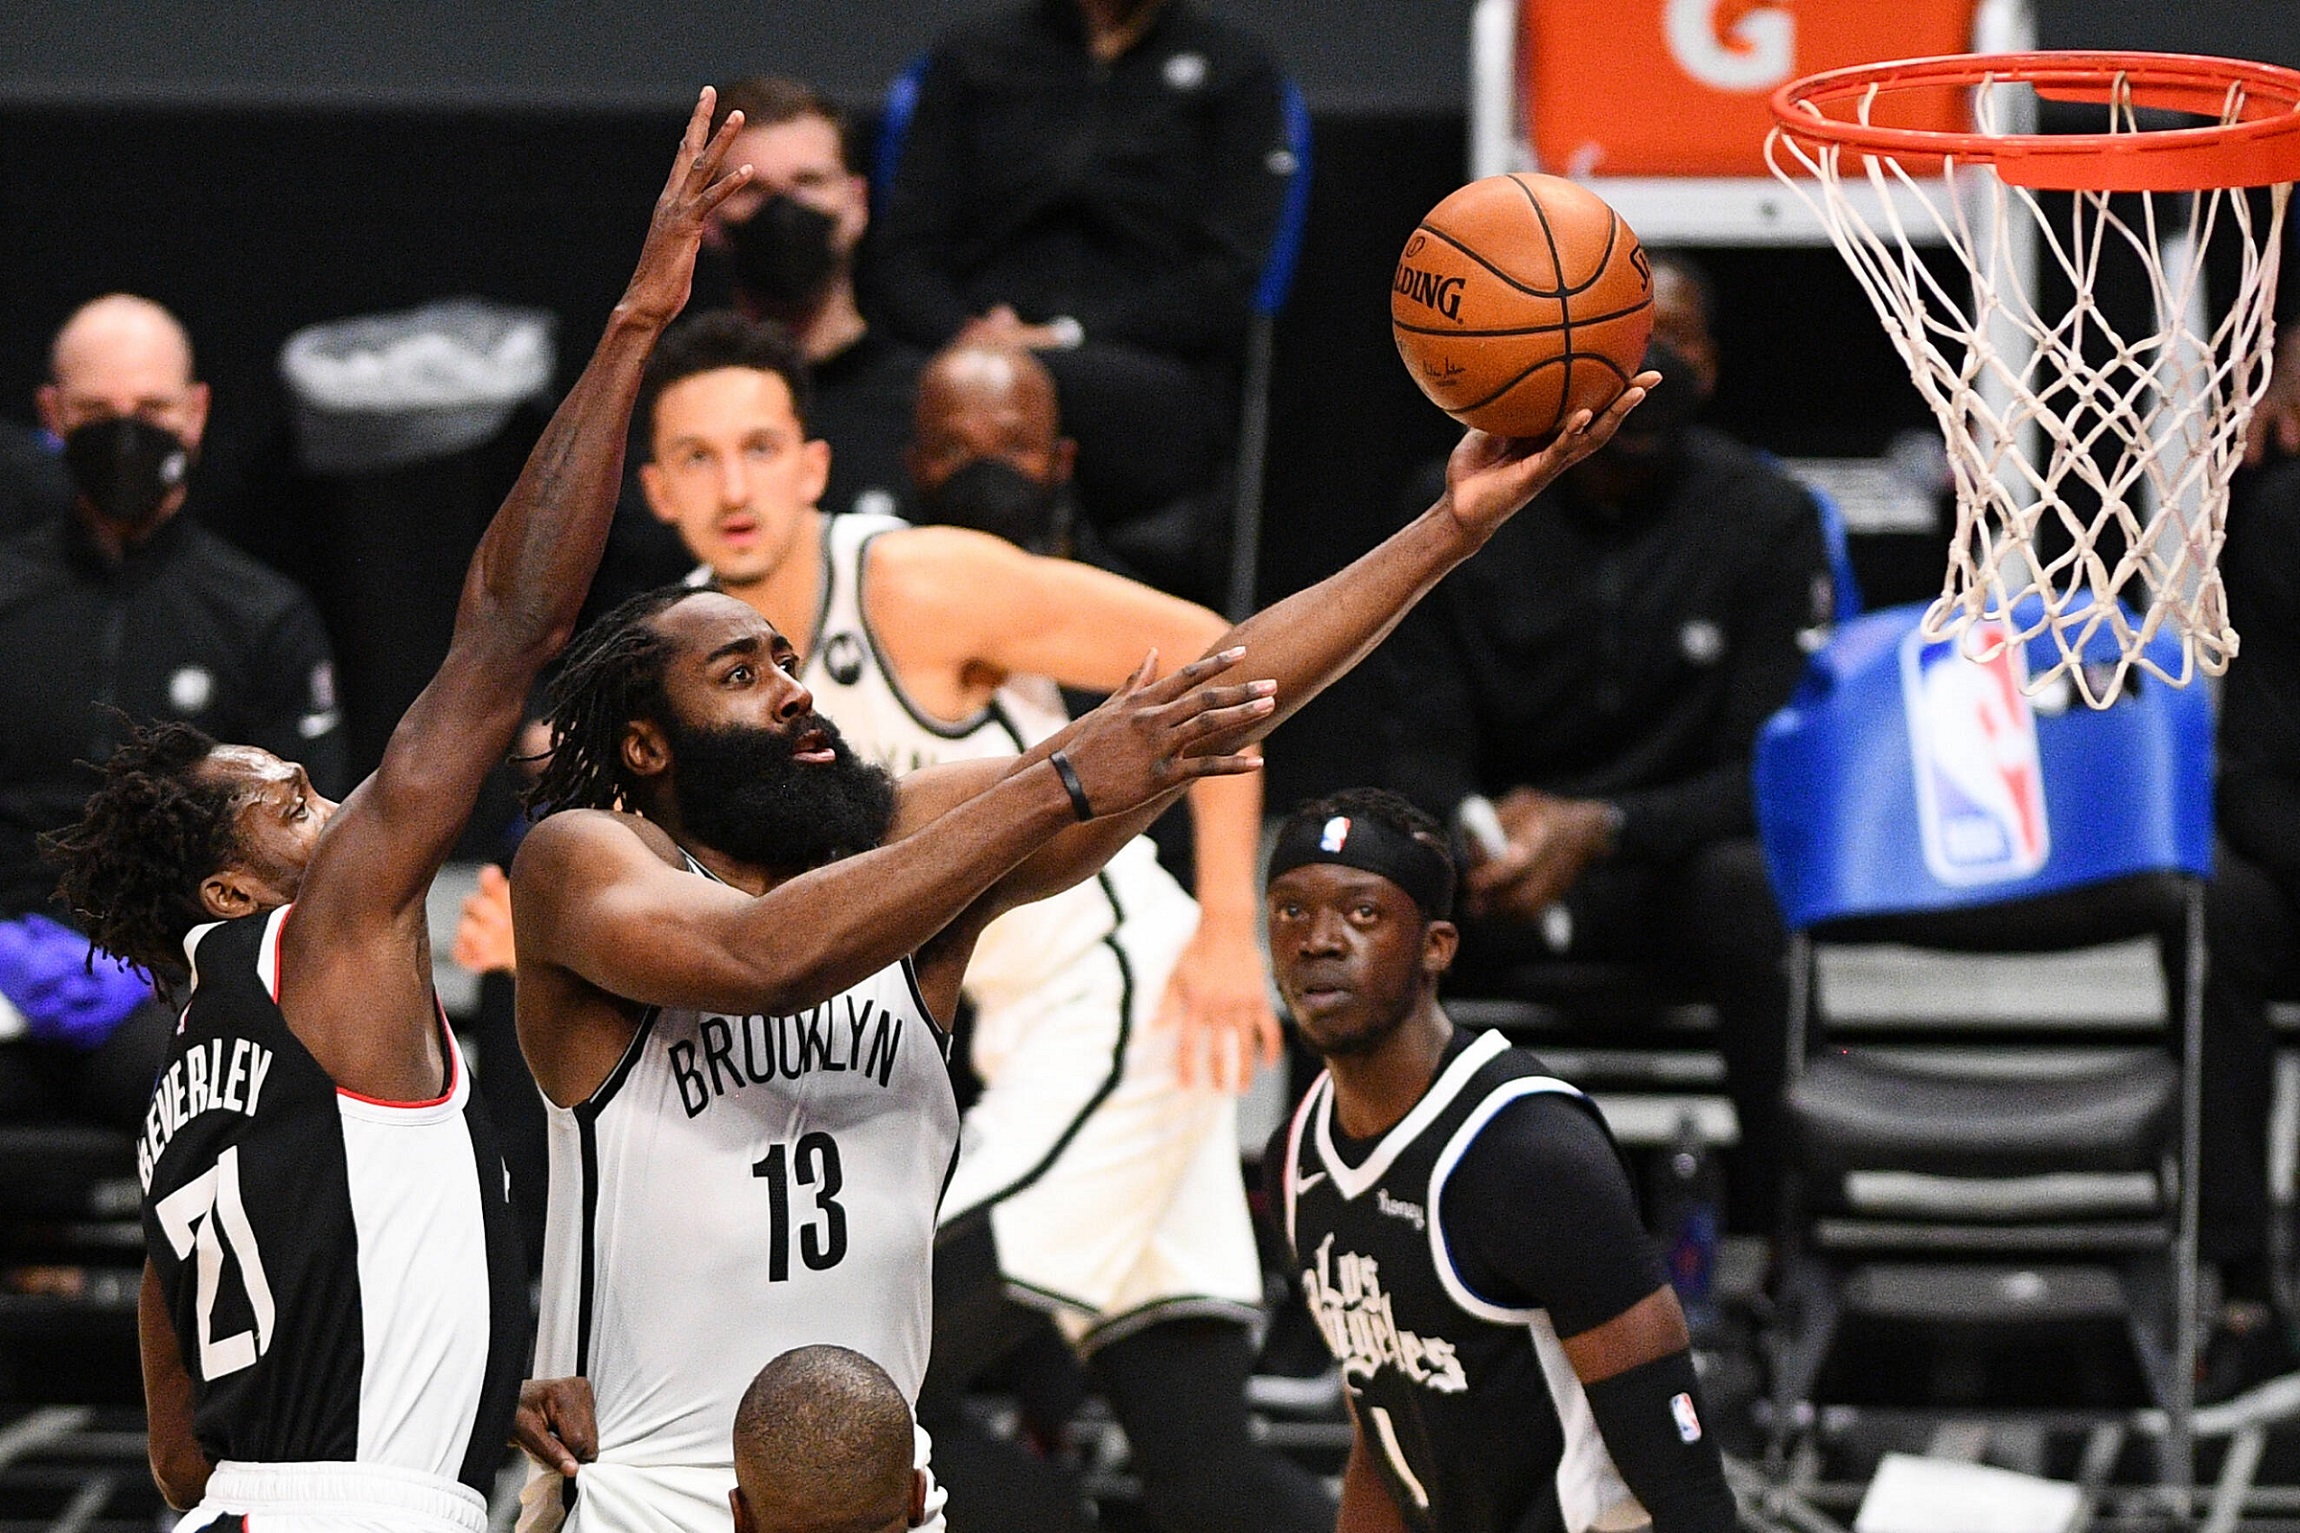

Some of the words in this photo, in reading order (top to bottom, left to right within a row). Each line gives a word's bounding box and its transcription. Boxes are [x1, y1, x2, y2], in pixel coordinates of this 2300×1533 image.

[1662, 0, 1797, 92] G
[1394, 263, 1466, 321] LDING
[136, 1037, 273, 1196] BEVERLEY
[668, 994, 903, 1119] BROOKLYN
[155, 1144, 275, 1382] 21
[752, 1131, 848, 1282] 13
